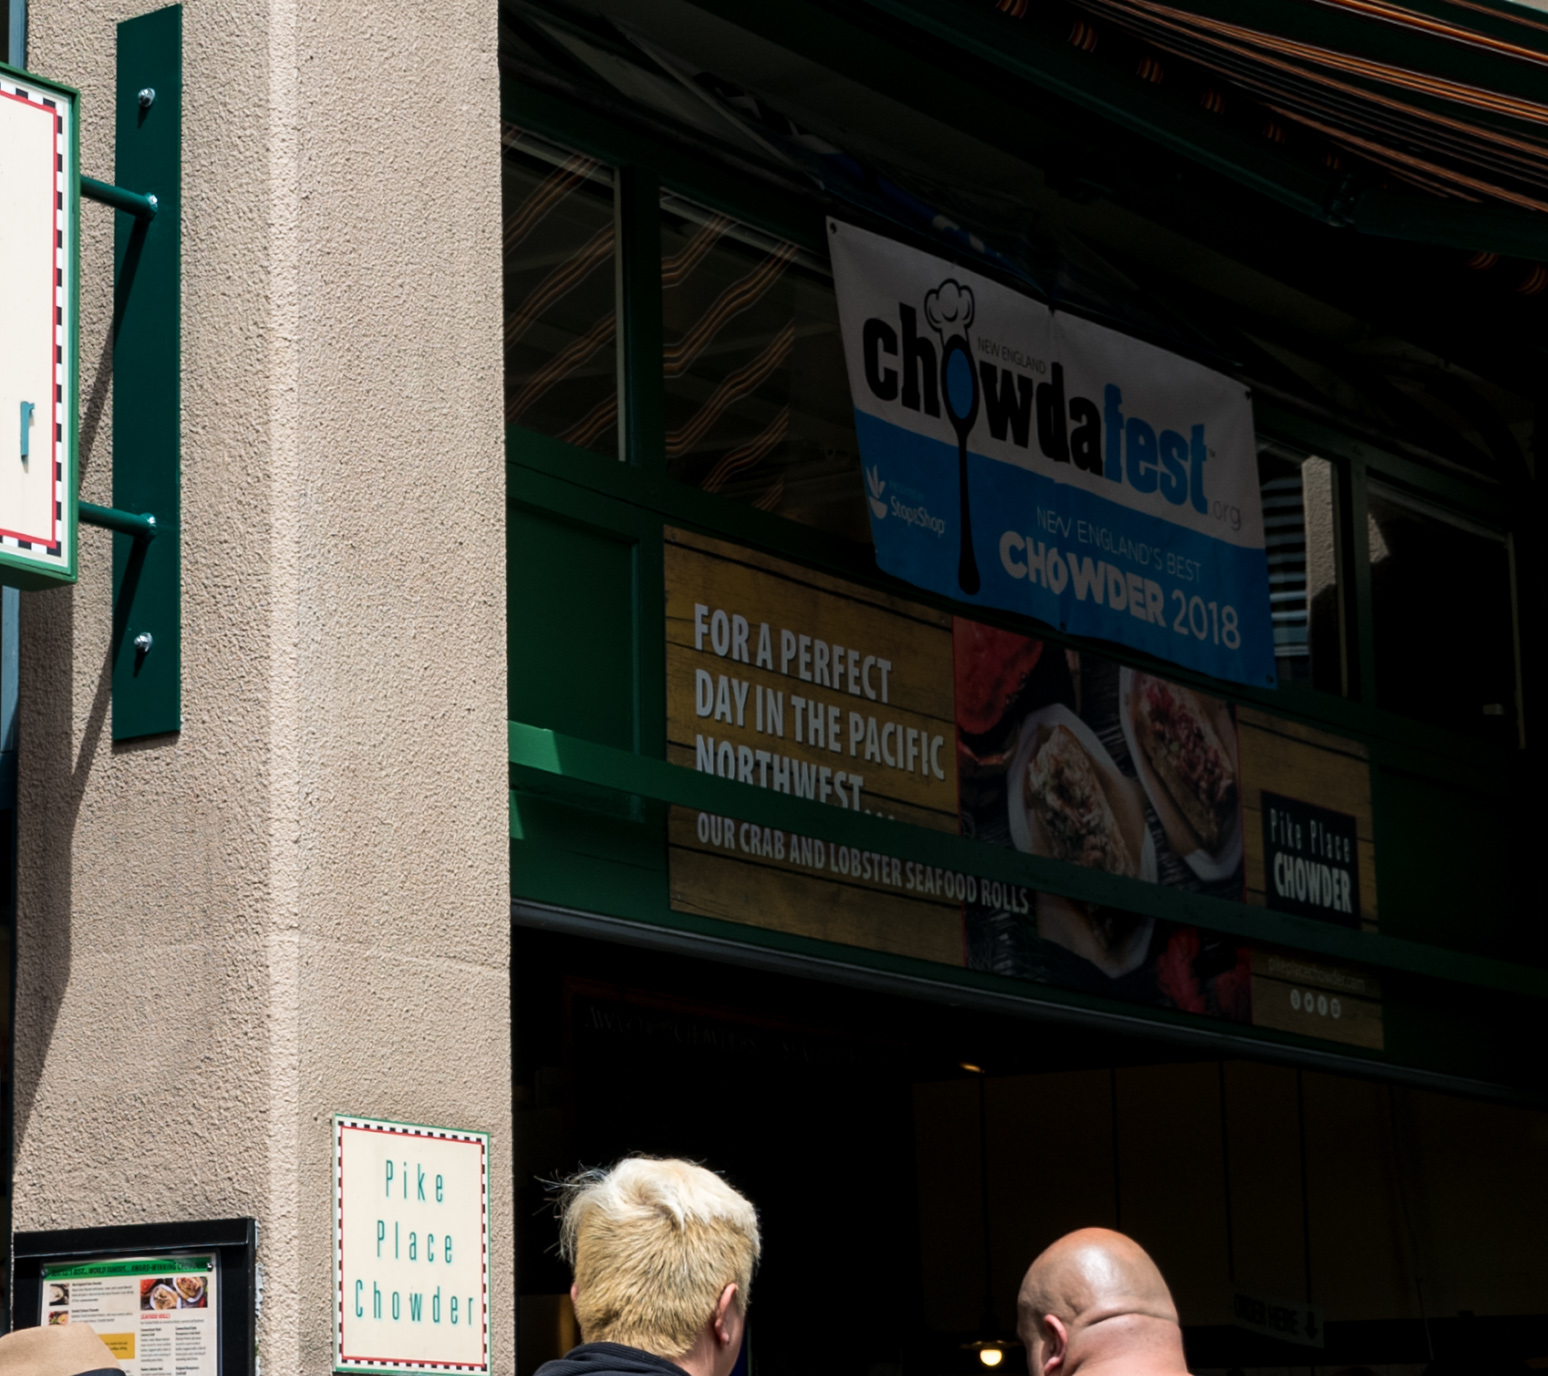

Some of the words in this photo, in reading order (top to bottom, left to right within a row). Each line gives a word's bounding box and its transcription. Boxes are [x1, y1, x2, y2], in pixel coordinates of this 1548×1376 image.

[977, 337, 1001, 357] NEW
[1002, 342, 1047, 375] ENGLAND
[1036, 505, 1073, 538] NEW
[1077, 519, 1163, 571] ENGLAND'S
[1167, 552, 1203, 583] BEST
[998, 530, 1166, 628] CHOWDER
[1171, 589, 1242, 651] 2018
[693, 602, 750, 666] FOR
[755, 621, 774, 671] A
[781, 628, 892, 704] PERFECT
[695, 668, 749, 728] DAY
[756, 684, 785, 738] IN
[790, 694, 842, 753] THE
[849, 711, 946, 781] PACIFIC
[696, 812, 736, 852] OUR
[739, 822, 785, 862] CRAB
[789, 835, 826, 870] AND
[830, 844, 903, 888] LOBSTER
[905, 862, 977, 905] SEAFOOD
[980, 878, 1030, 915] ROLLS
[1269, 807, 1303, 852] Pike
[1309, 818, 1352, 865] Place
[1273, 850, 1353, 915] CHOWDER
[385, 1159, 444, 1203] Pike
[377, 1219, 453, 1264] Place
[354, 1279, 474, 1326] Chowder
